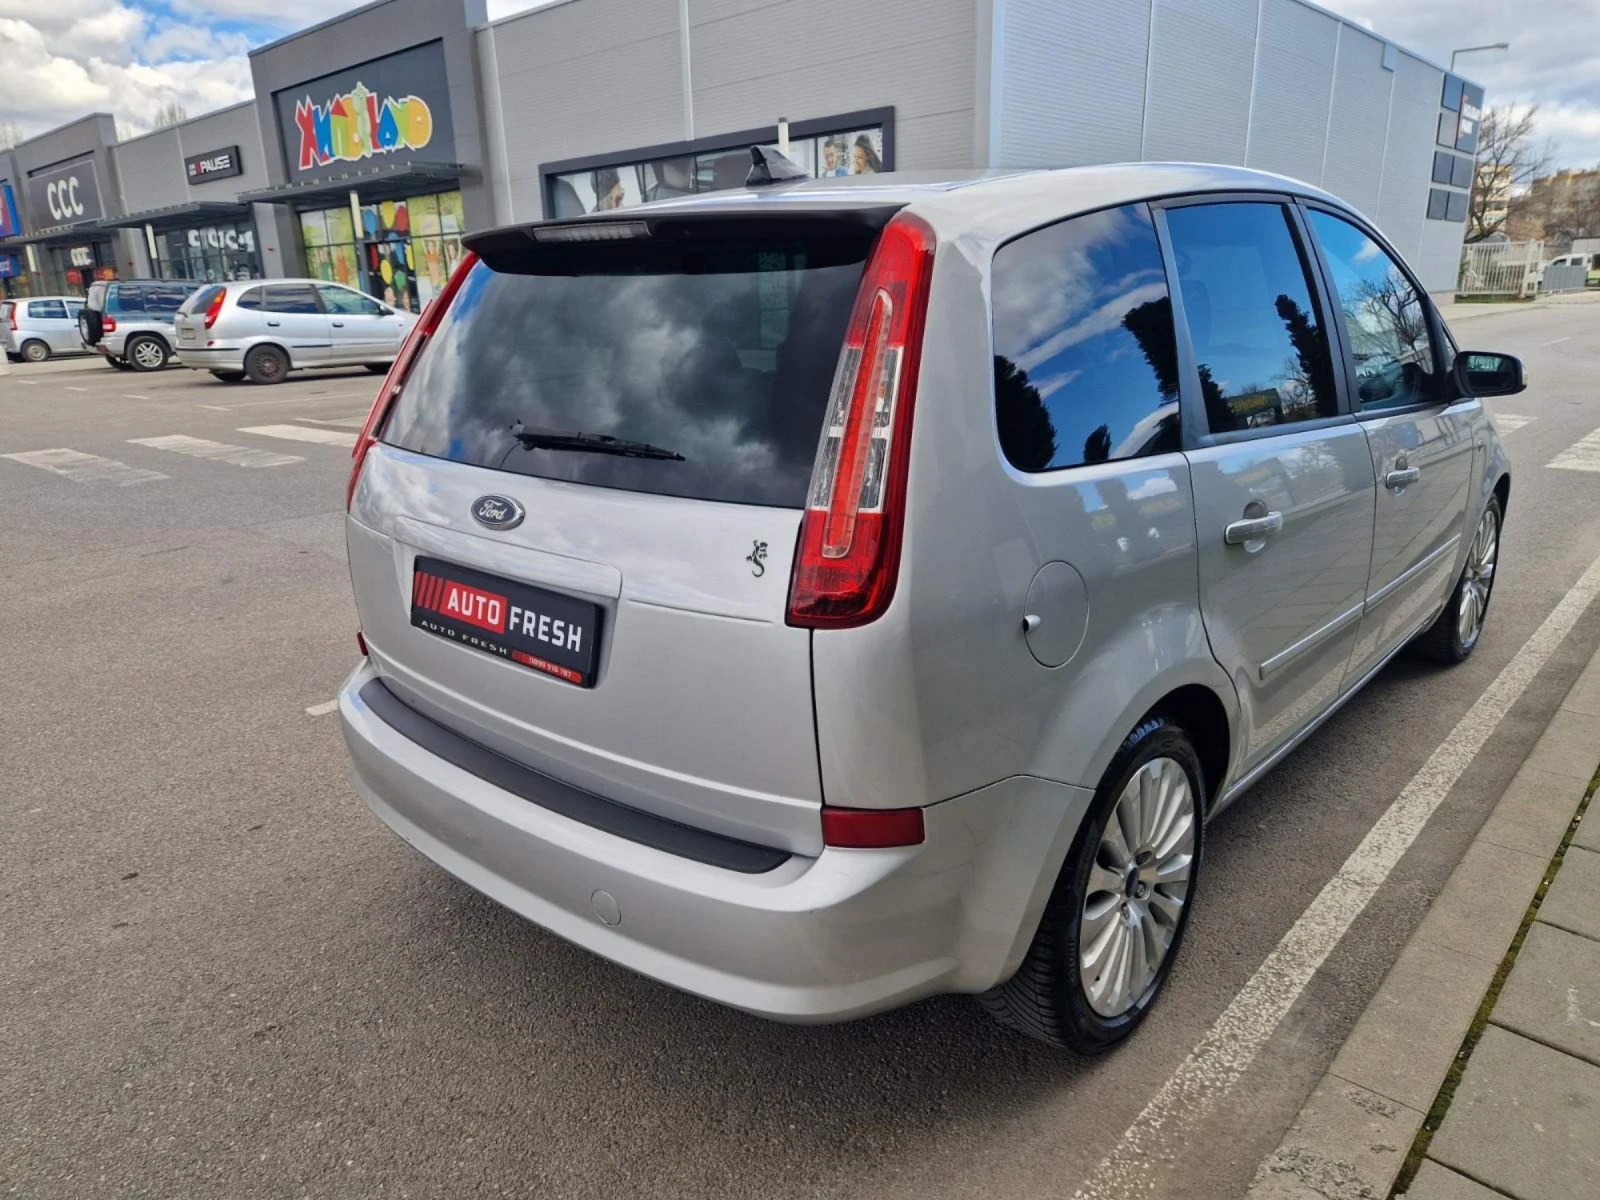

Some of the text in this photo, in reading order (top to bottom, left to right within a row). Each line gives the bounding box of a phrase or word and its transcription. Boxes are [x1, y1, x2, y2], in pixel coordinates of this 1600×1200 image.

[47, 176, 84, 220] CCC
[479, 499, 508, 520] Ford
[420, 620, 507, 656] AUTO FRESH
[447, 588, 582, 653] AUTO FRESH
